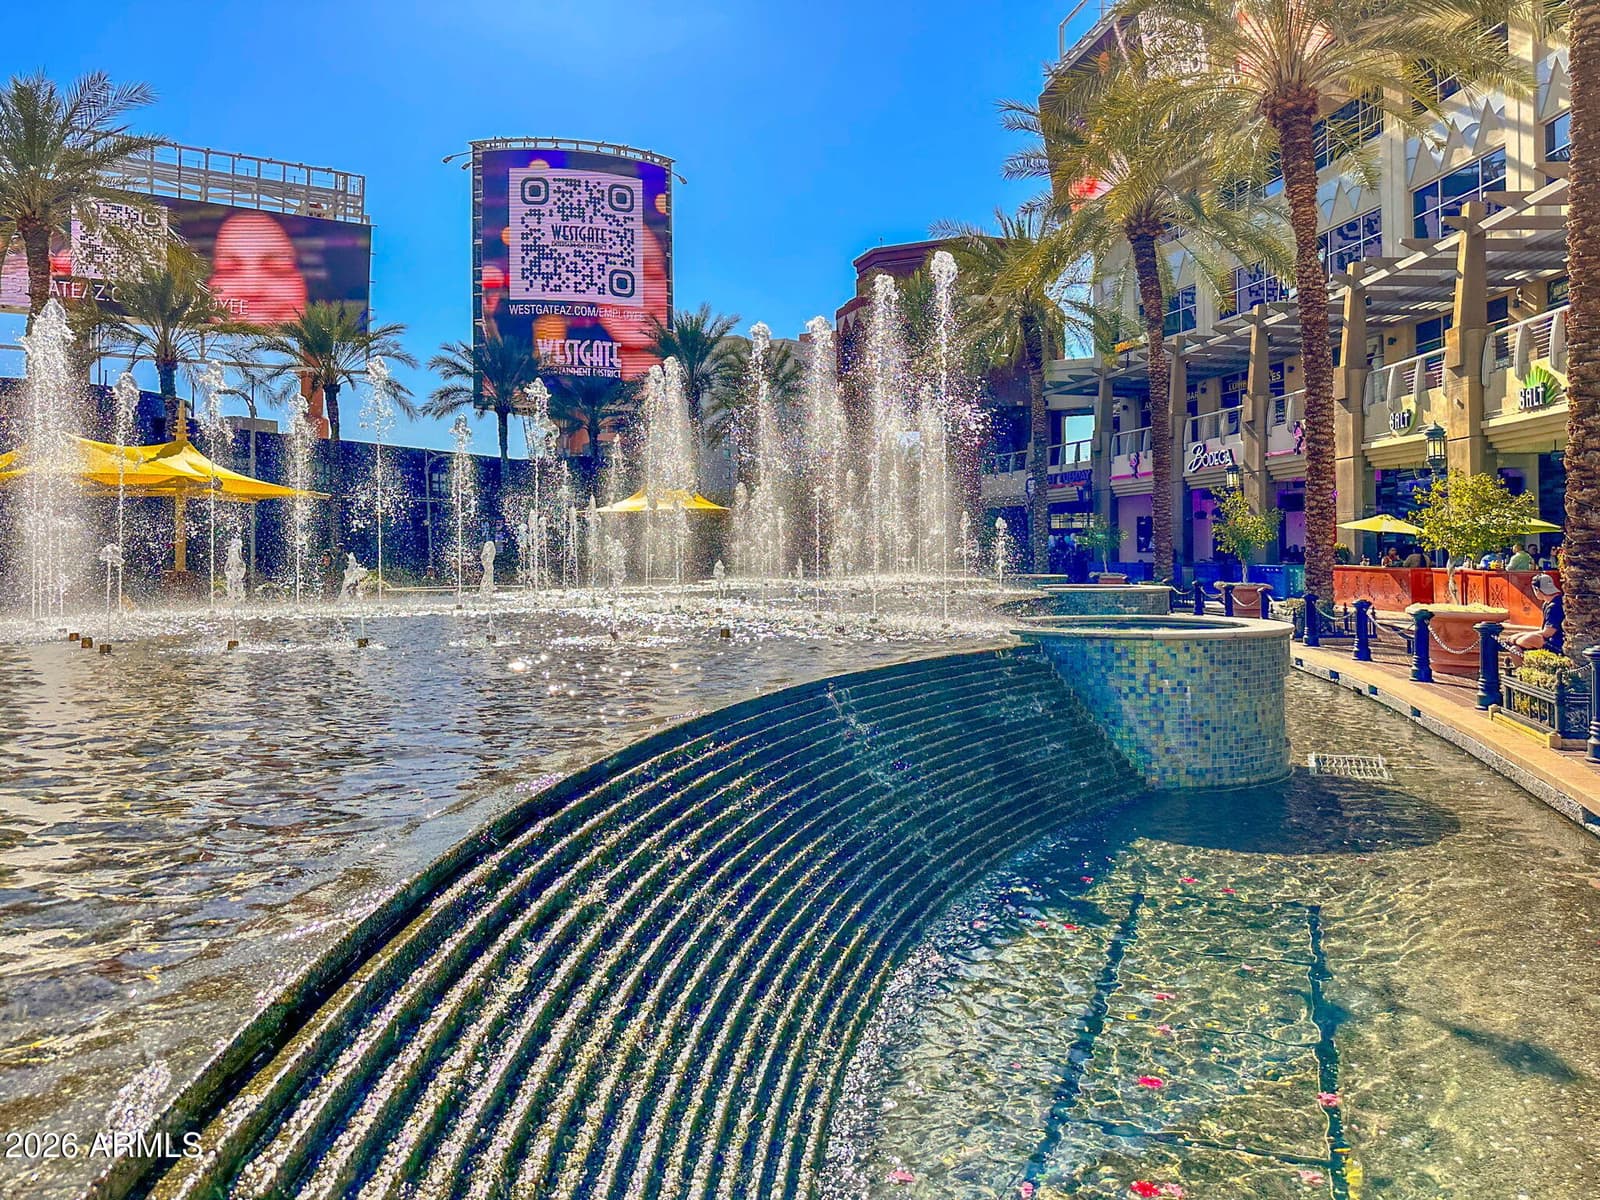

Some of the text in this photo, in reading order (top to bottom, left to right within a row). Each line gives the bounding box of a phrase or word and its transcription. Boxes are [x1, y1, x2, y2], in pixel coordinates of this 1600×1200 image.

[551, 224, 607, 243] WESTGATE
[536, 338, 622, 368] WESTGATE
[538, 366, 591, 377] TAINMENT
[1518, 385, 1545, 409] SALT
[1389, 412, 1410, 430] SALT
